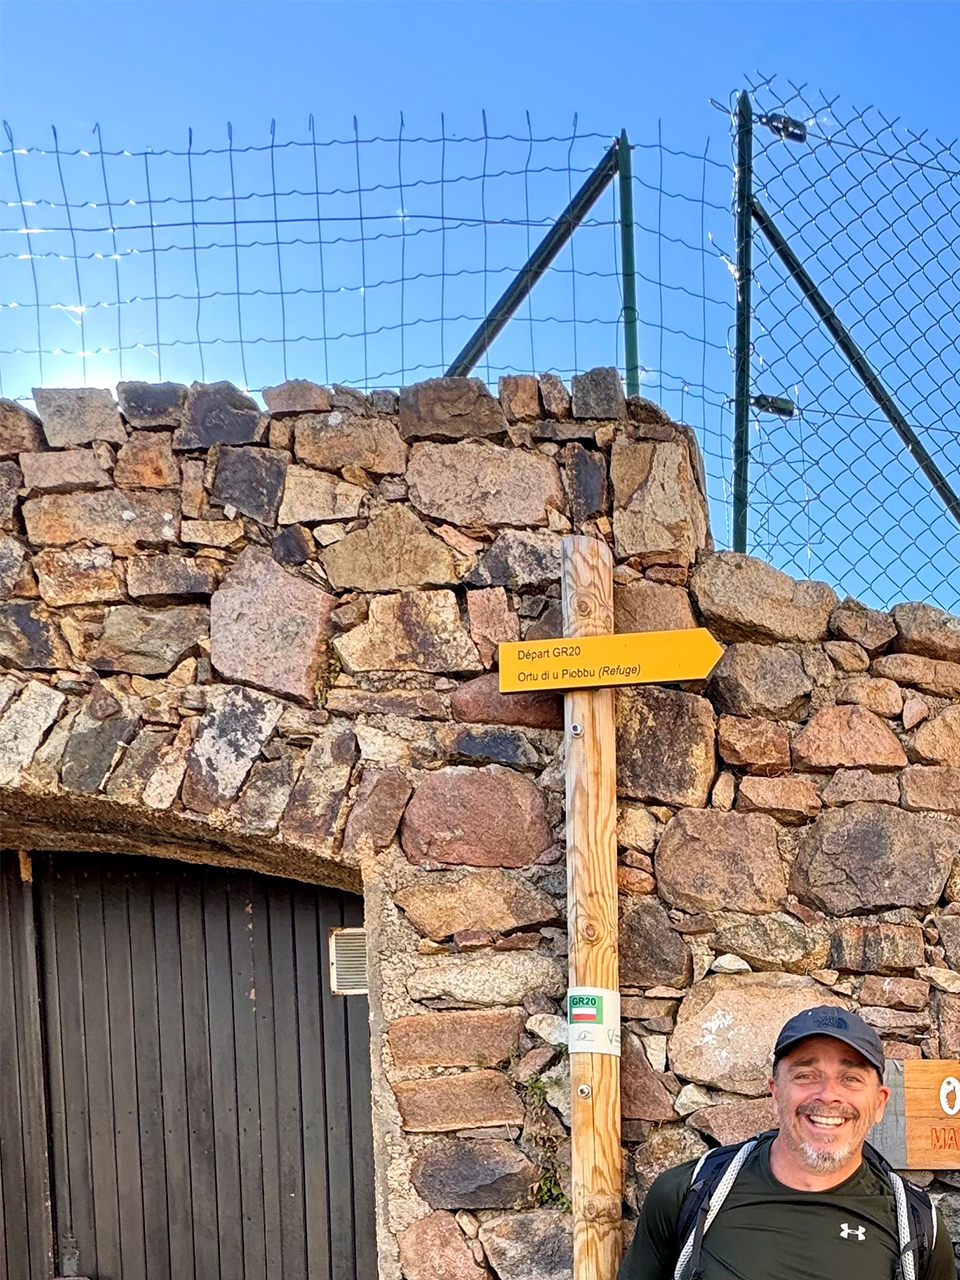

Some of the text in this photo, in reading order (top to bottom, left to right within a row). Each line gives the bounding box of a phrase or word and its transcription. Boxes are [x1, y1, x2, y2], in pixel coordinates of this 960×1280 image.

[517, 645, 581, 661] Départ GR20
[517, 664, 641, 682] Ortu di u Piobbu (Refuge)
[572, 997, 597, 1006] GR20
